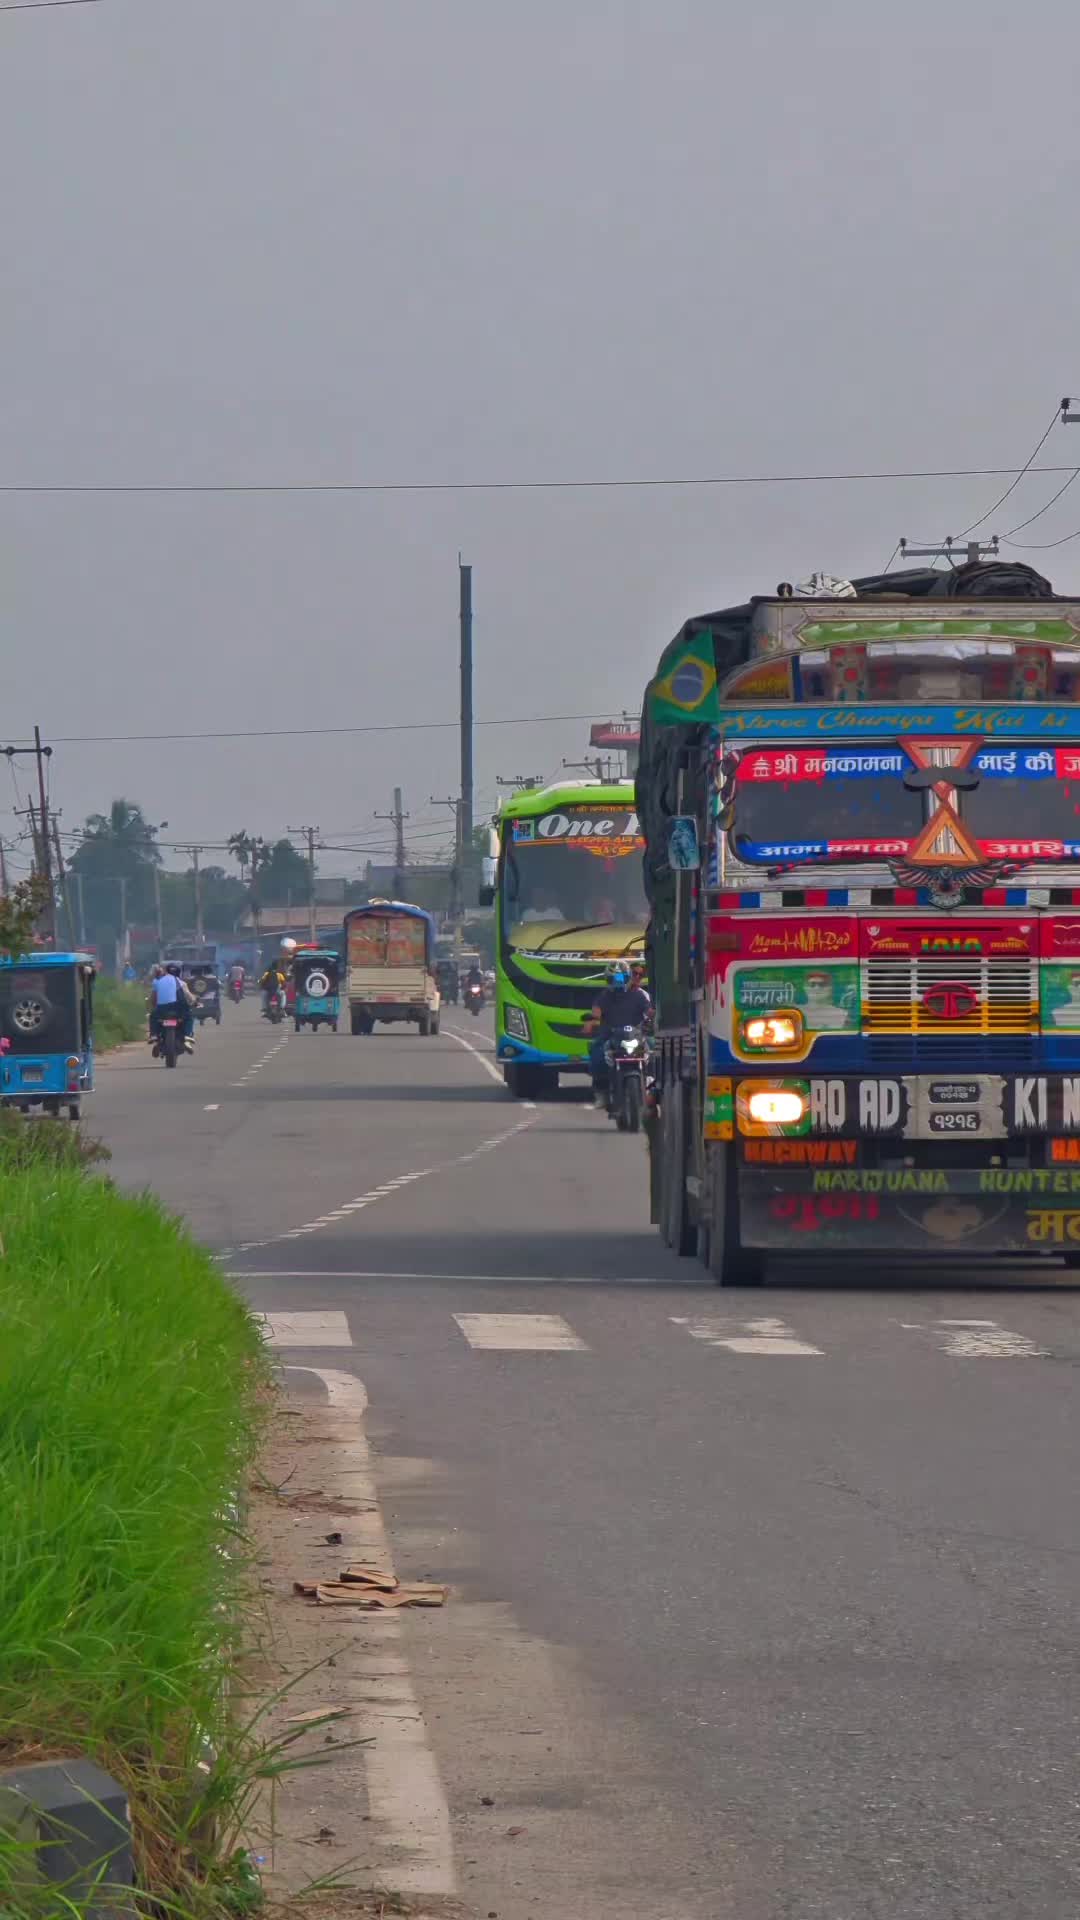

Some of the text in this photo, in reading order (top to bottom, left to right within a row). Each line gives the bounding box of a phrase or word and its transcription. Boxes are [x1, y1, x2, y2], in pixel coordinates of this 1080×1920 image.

[774, 753, 903, 775] श्री मनकामना
[977, 751, 1018, 773] माई
[1025, 752, 1055, 771] की
[538, 814, 615, 837] One
[934, 1112, 977, 1130] १२१६
[813, 1169, 949, 1193] MARIJUANA
